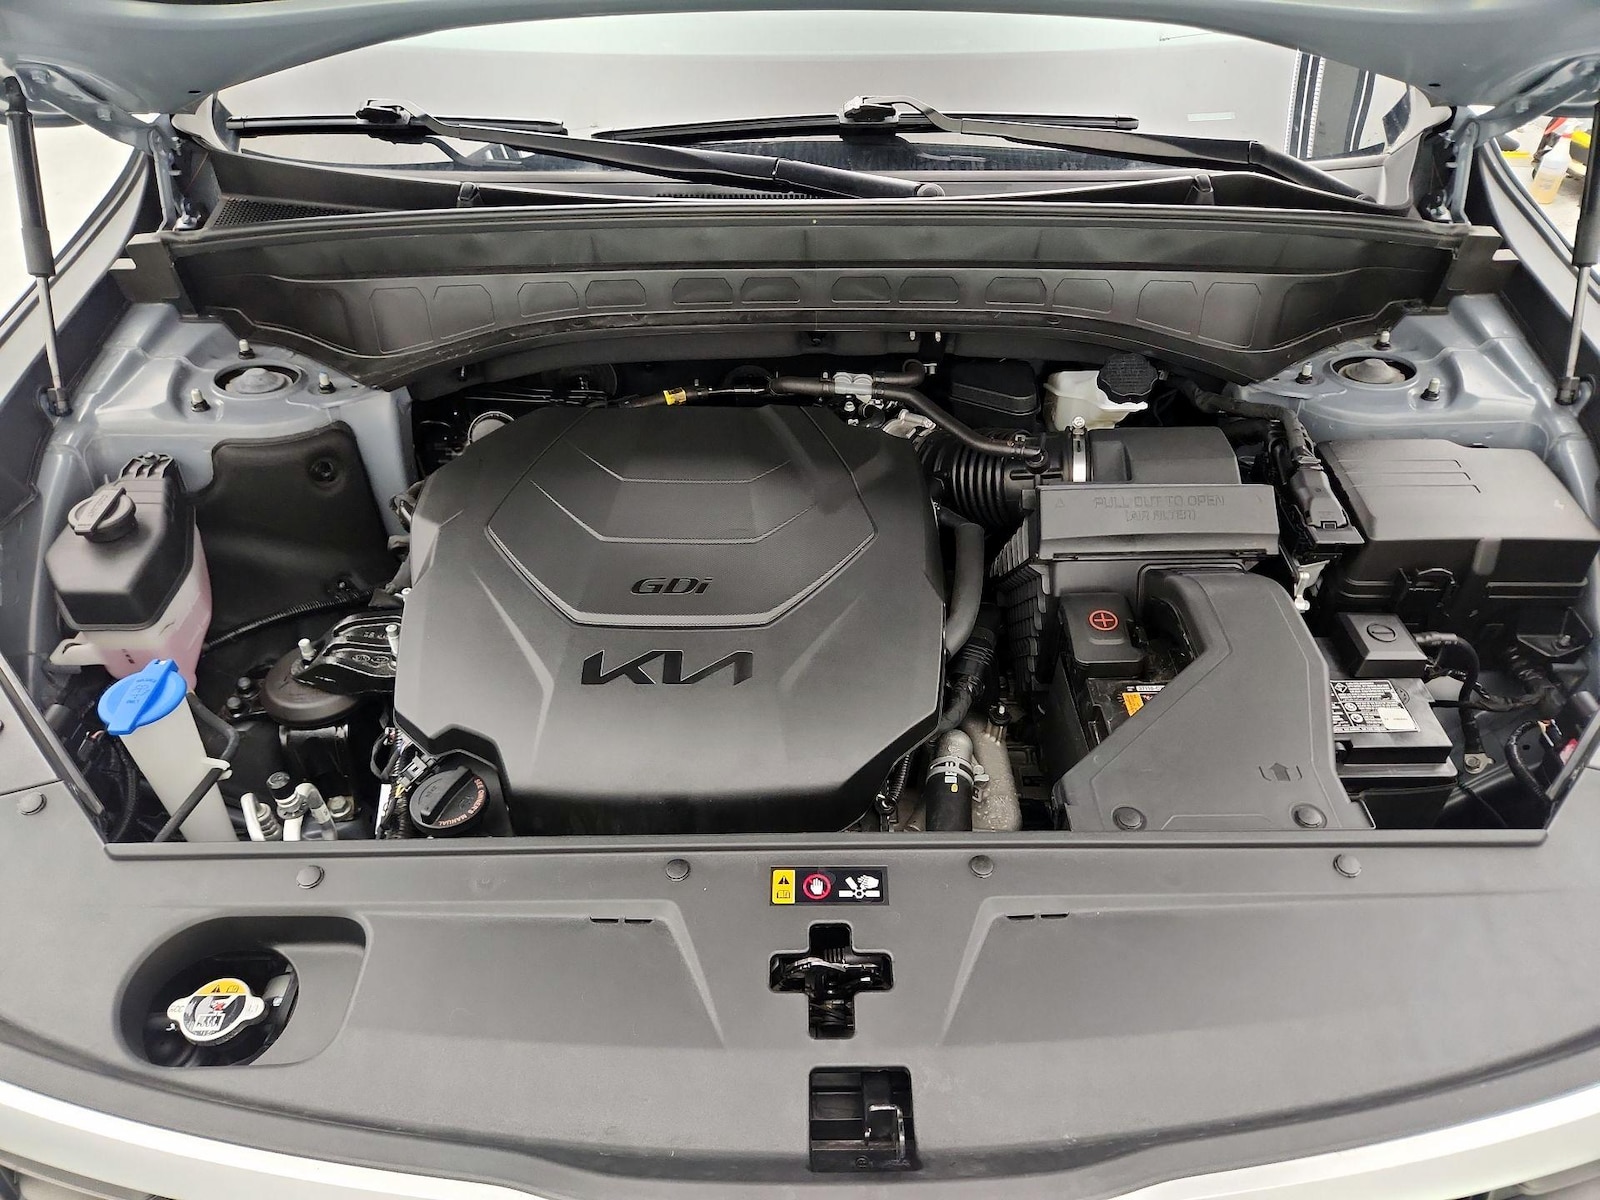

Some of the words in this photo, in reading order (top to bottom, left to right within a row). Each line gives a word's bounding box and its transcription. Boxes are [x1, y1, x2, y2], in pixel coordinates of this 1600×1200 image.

[1134, 495, 1162, 508] OUT
[1165, 495, 1184, 507] TO
[1187, 494, 1225, 507] OPEN
[630, 576, 713, 595] GDi
[581, 649, 753, 686] KIA
[439, 813, 468, 826] MANUAL
